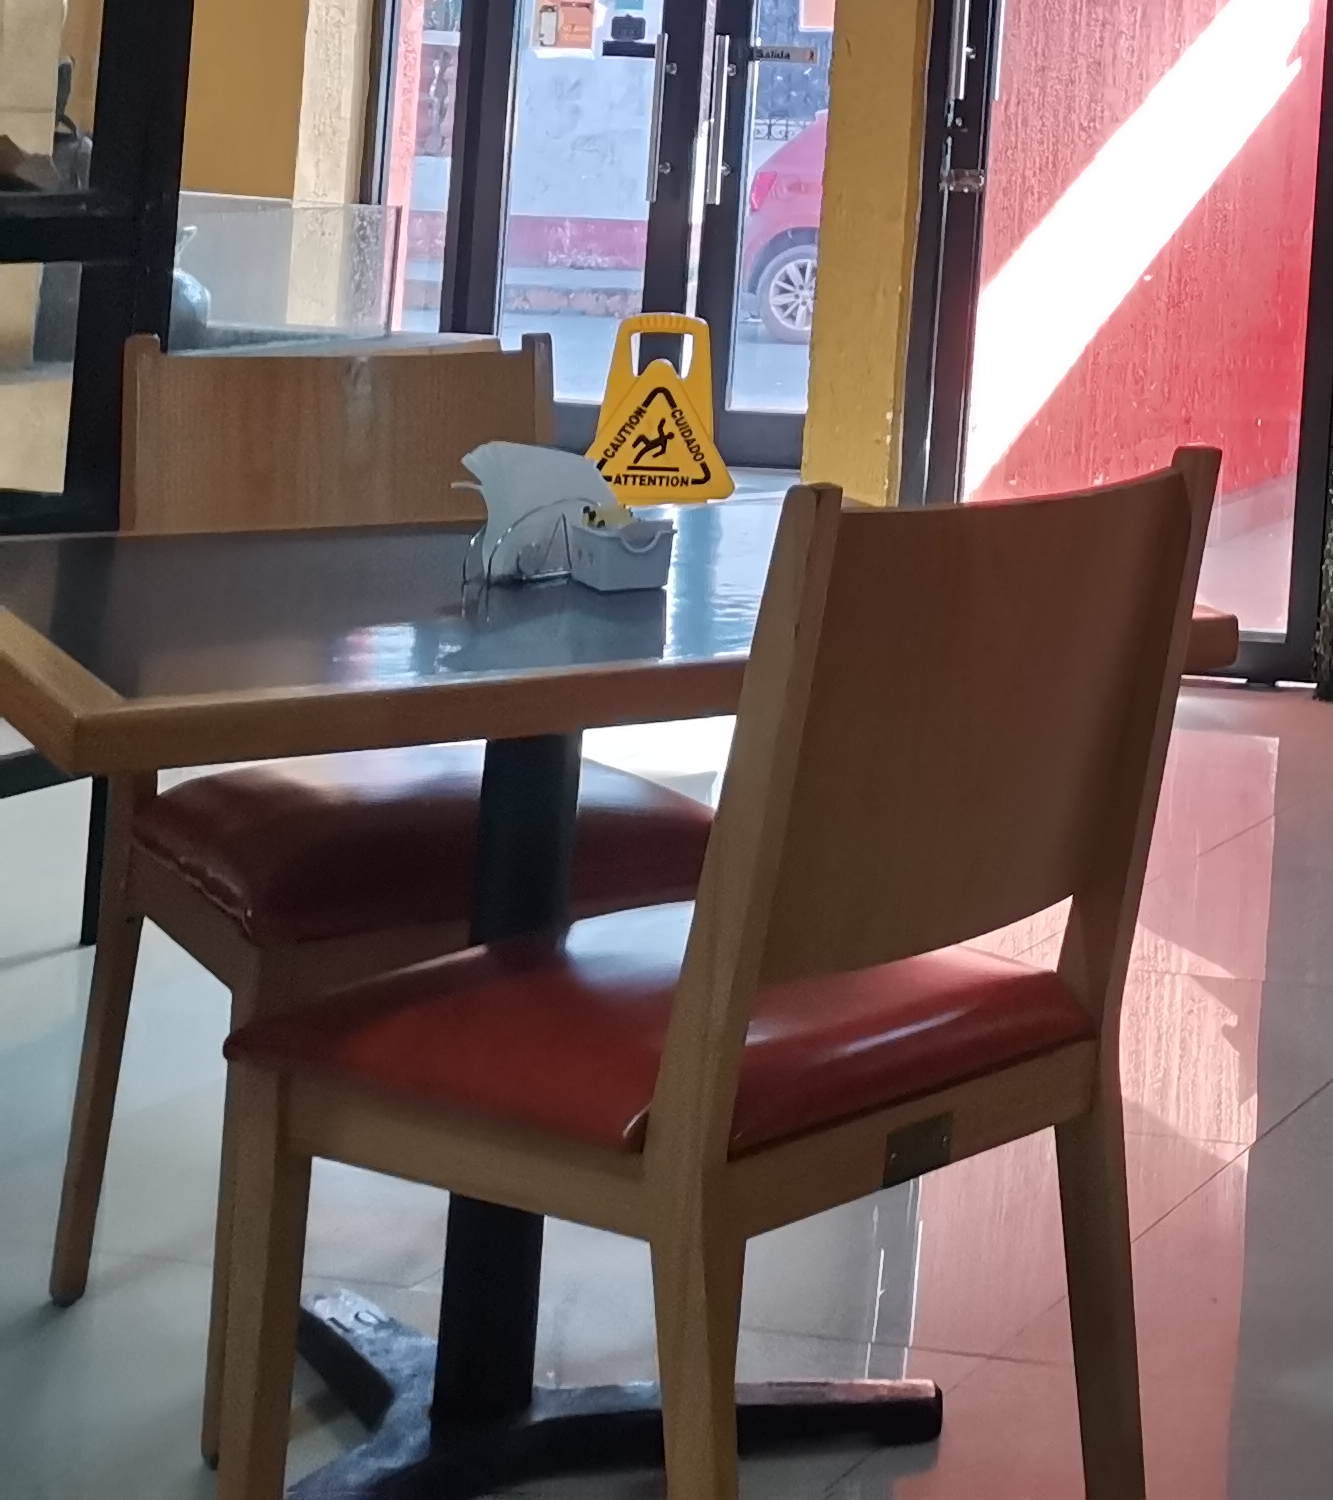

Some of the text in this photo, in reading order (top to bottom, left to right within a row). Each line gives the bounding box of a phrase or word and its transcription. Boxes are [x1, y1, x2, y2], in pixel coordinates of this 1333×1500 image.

[603, 405, 647, 459] CAUTION
[671, 408, 705, 463] CUIDADO
[613, 473, 690, 488] ATTENTION
